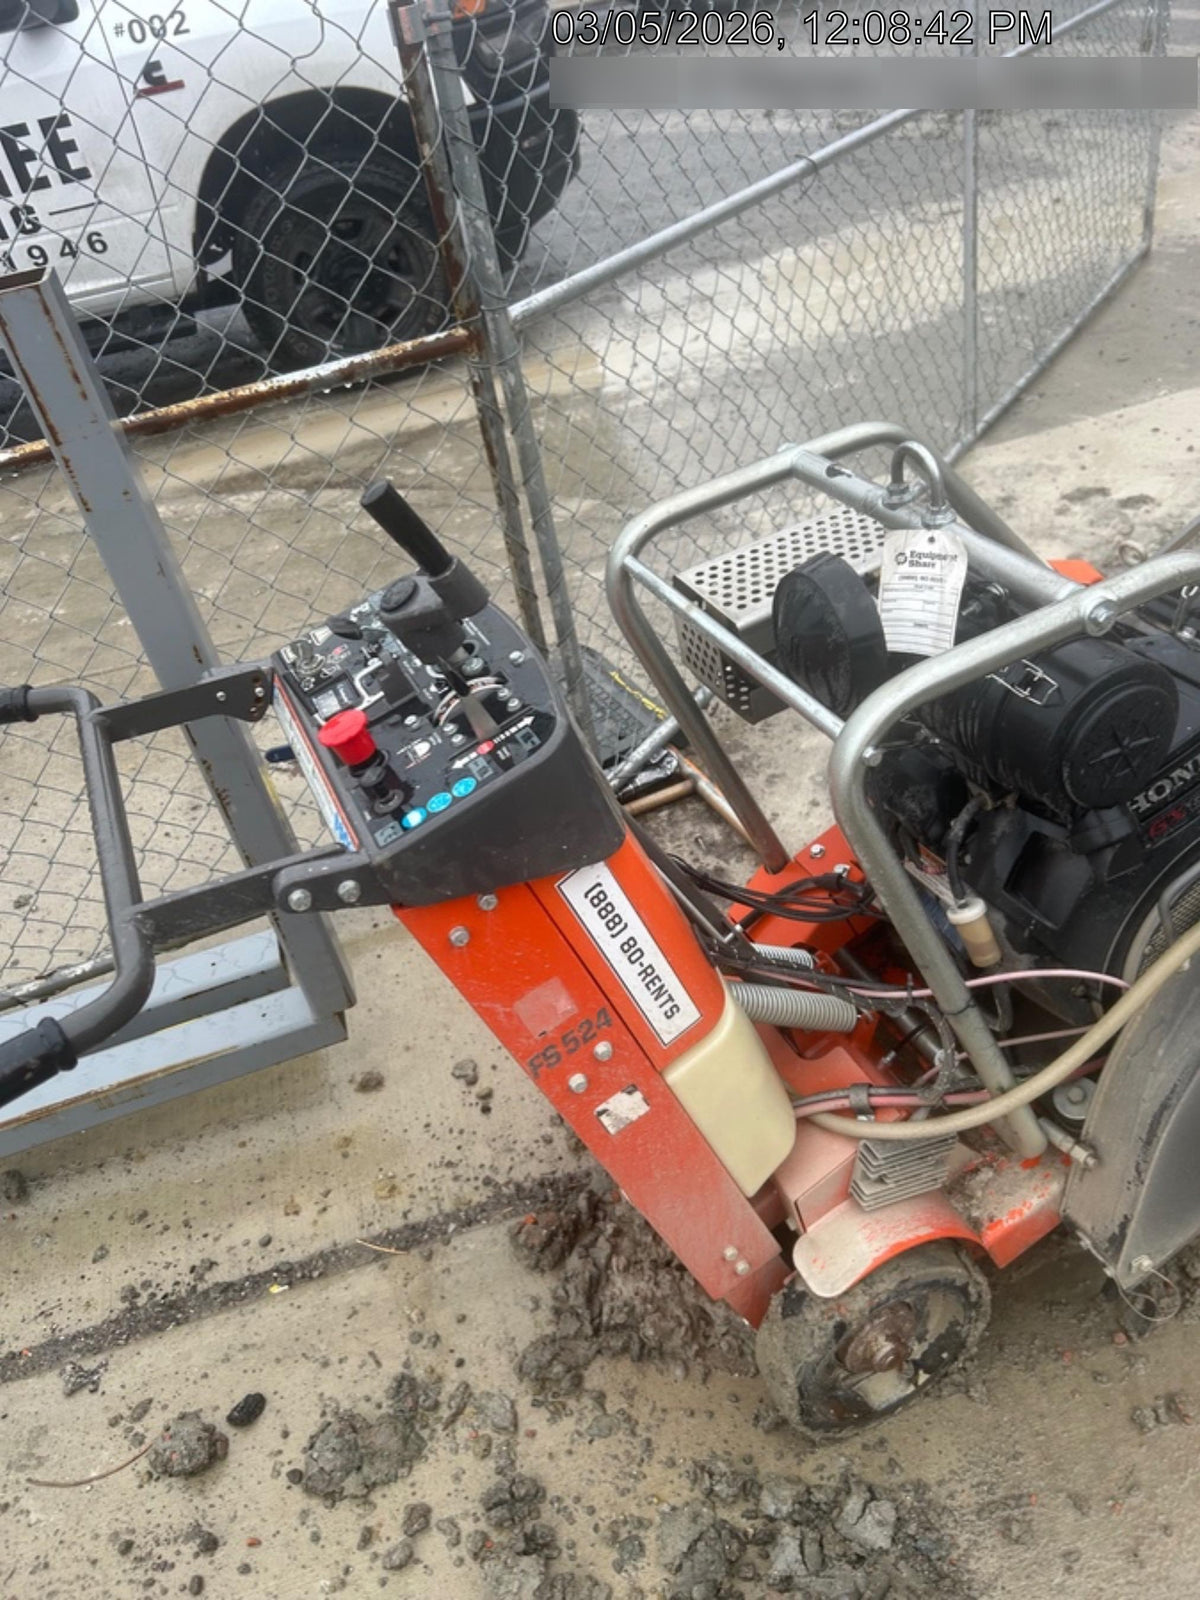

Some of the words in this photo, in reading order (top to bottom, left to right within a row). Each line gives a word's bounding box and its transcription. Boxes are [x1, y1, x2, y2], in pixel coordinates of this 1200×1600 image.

[113, 10, 190, 44] #002
[584, 882, 628, 938] (888)
[620, 936, 680, 1019] 80-RENTS
[528, 1044, 562, 1078] FS
[562, 1007, 612, 1053] 524
